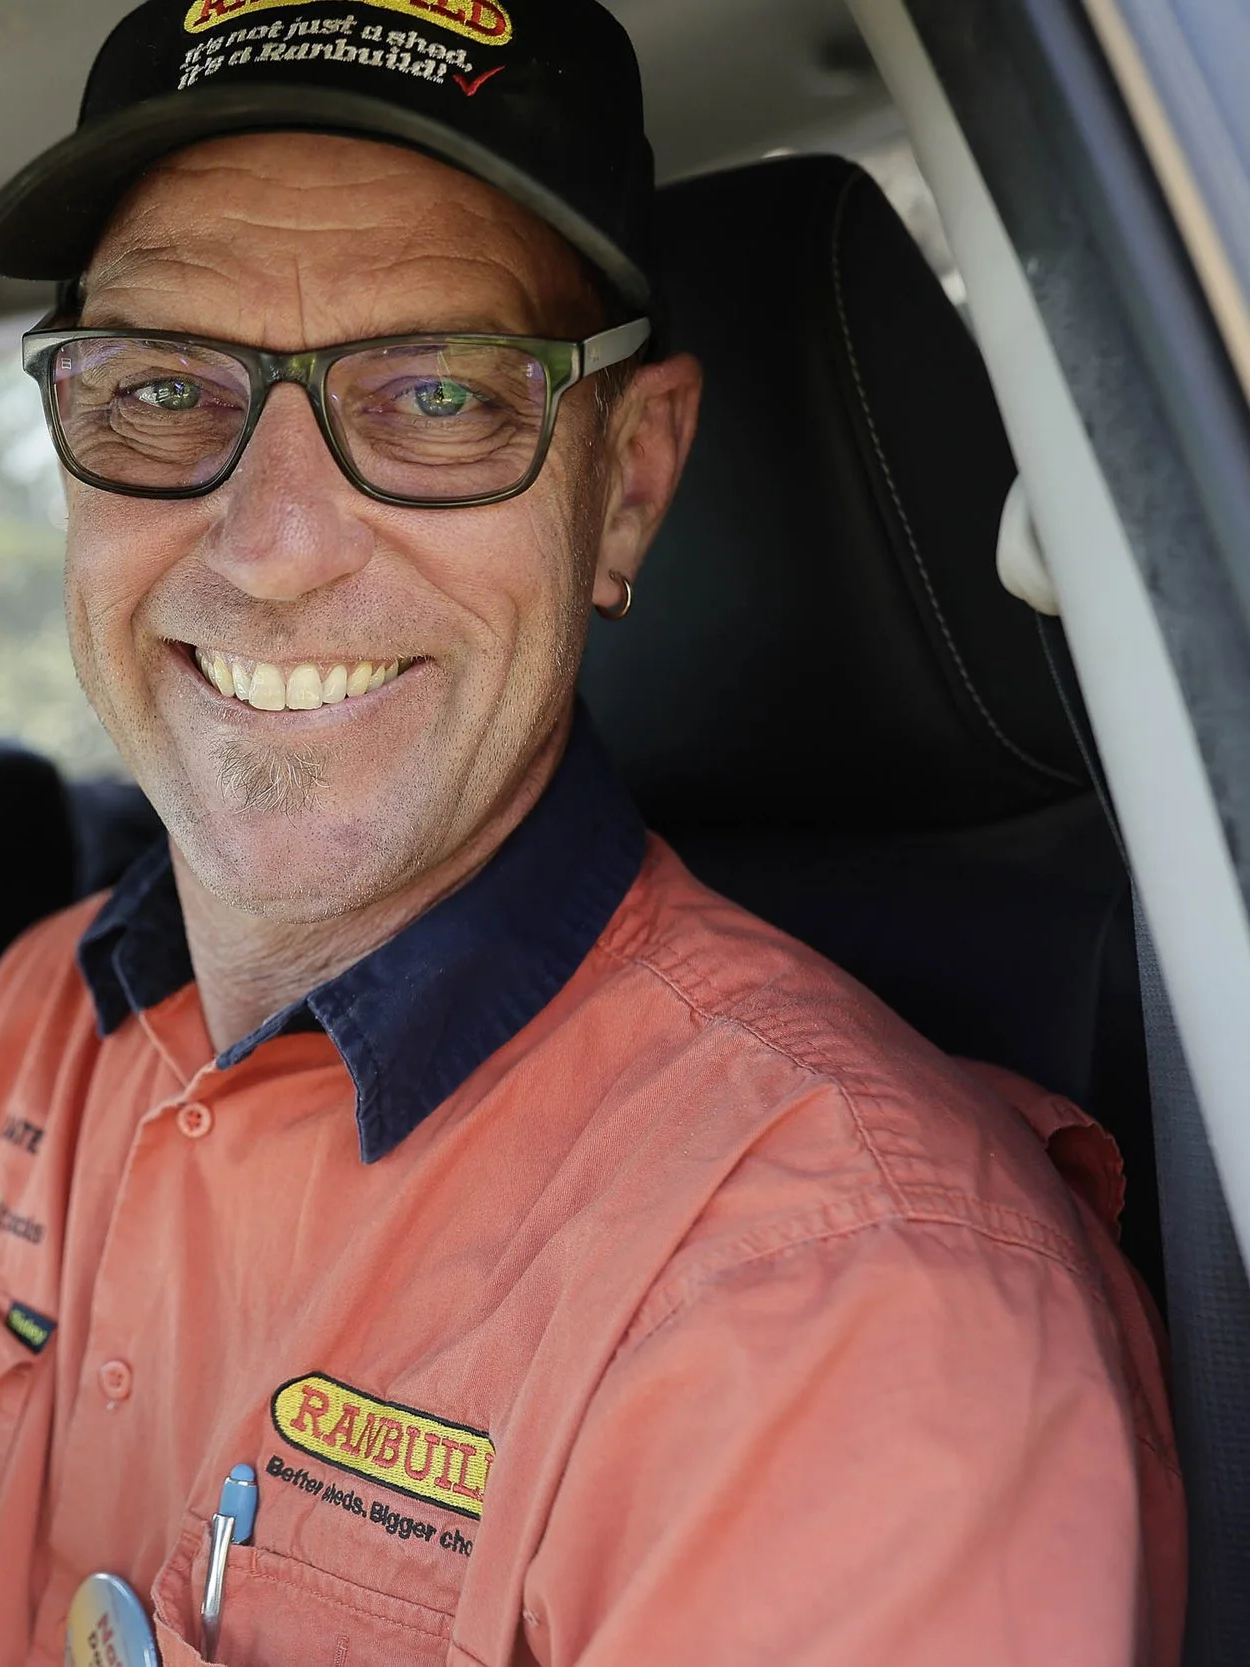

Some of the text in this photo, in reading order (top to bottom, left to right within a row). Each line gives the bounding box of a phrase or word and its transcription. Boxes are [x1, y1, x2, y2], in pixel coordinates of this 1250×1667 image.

[225, 20, 285, 47] not
[283, 15, 358, 41] just
[361, 25, 383, 41] a
[386, 30, 473, 72] shed,
[228, 46, 253, 66] a
[253, 38, 448, 84] Ranbuild!
[290, 1385, 494, 1504] RANBUIL
[266, 1454, 324, 1496] Better
[370, 1501, 437, 1542] Bigger
